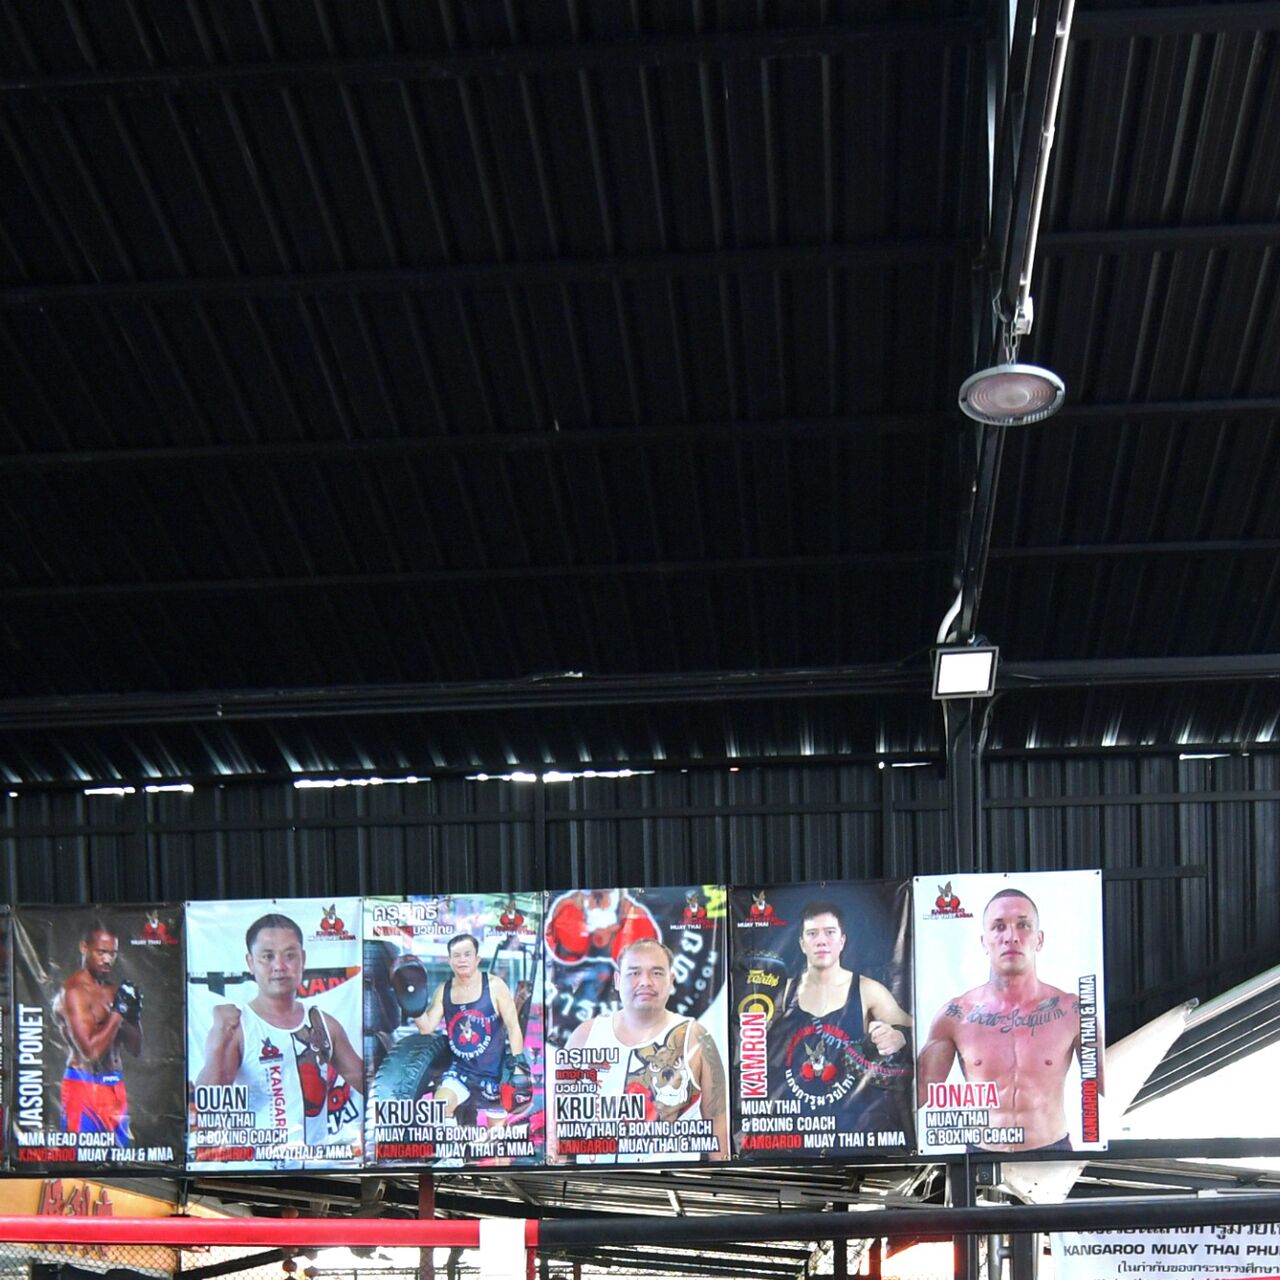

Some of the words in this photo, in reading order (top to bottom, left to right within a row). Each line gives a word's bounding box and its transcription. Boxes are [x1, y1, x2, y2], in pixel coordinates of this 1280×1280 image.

[1080, 975, 1096, 1004] MMA
[19, 1004, 43, 1065] PONET
[1081, 1016, 1097, 1045] THAI
[740, 1012, 768, 1098] KAMRON
[1081, 1046, 1097, 1079] MUAY
[19, 1070, 43, 1129] JASON
[196, 1085, 248, 1111] OUAN
[927, 1081, 1000, 1109] JONATA
[374, 1099, 412, 1125] KRU
[416, 1099, 448, 1125] SIT
[556, 1094, 595, 1121] KRU
[599, 1093, 645, 1120] MAN
[741, 1100, 772, 1115] MUAY
[775, 1100, 801, 1115] THAI
[1082, 1080, 1099, 1142] KANGAROO
[197, 1113, 227, 1129] MUAY
[230, 1112, 255, 1128] THAI
[741, 1118, 750, 1131] &
[752, 1117, 793, 1132] BOXING
[797, 1116, 836, 1131] COACH
[927, 1112, 959, 1127] MUAY
[962, 1111, 988, 1126] THAI
[207, 1129, 247, 1144] BOXING
[250, 1129, 288, 1144] COACH
[375, 1127, 406, 1142] MUAY
[407, 1126, 433, 1141] THAI
[445, 1126, 487, 1141] BOXING
[489, 1124, 528, 1140] COACH
[557, 1123, 588, 1138] MUAY
[591, 1122, 616, 1137] THAI
[618, 1122, 627, 1136] &
[628, 1121, 670, 1136] BOXING
[673, 1119, 712, 1135] COACH
[927, 1129, 936, 1145] &
[937, 1128, 980, 1144] BOXING
[983, 1127, 1024, 1143] COACH
[18, 1132, 45, 1147] MMA
[47, 1132, 77, 1146] HEAD
[78, 1132, 114, 1146] COACH
[558, 1139, 617, 1153] KANGAROO
[618, 1138, 649, 1153] MUAY
[652, 1137, 678, 1152] THAI
[691, 1136, 719, 1151] MMA
[741, 1134, 802, 1149] KANGAROO
[804, 1133, 835, 1148] MUAY
[838, 1133, 864, 1147] THAI
[867, 1132, 875, 1147] &
[877, 1131, 906, 1146] MMA
[77, 1148, 108, 1162] MUAY
[111, 1148, 136, 1162] THAI
[147, 1147, 174, 1161] MMA
[255, 1146, 287, 1161] MUAY
[288, 1146, 313, 1160] THAI
[325, 1145, 354, 1160] MMA
[376, 1144, 434, 1158] KANGAROO
[435, 1142, 467, 1157] MUAY
[469, 1142, 494, 1157] THAI
[507, 1141, 534, 1156] MMA
[1063, 1244, 1145, 1256] KANGAROO
[1151, 1244, 1198, 1256] MUAY
[1204, 1244, 1240, 1256] THAI
